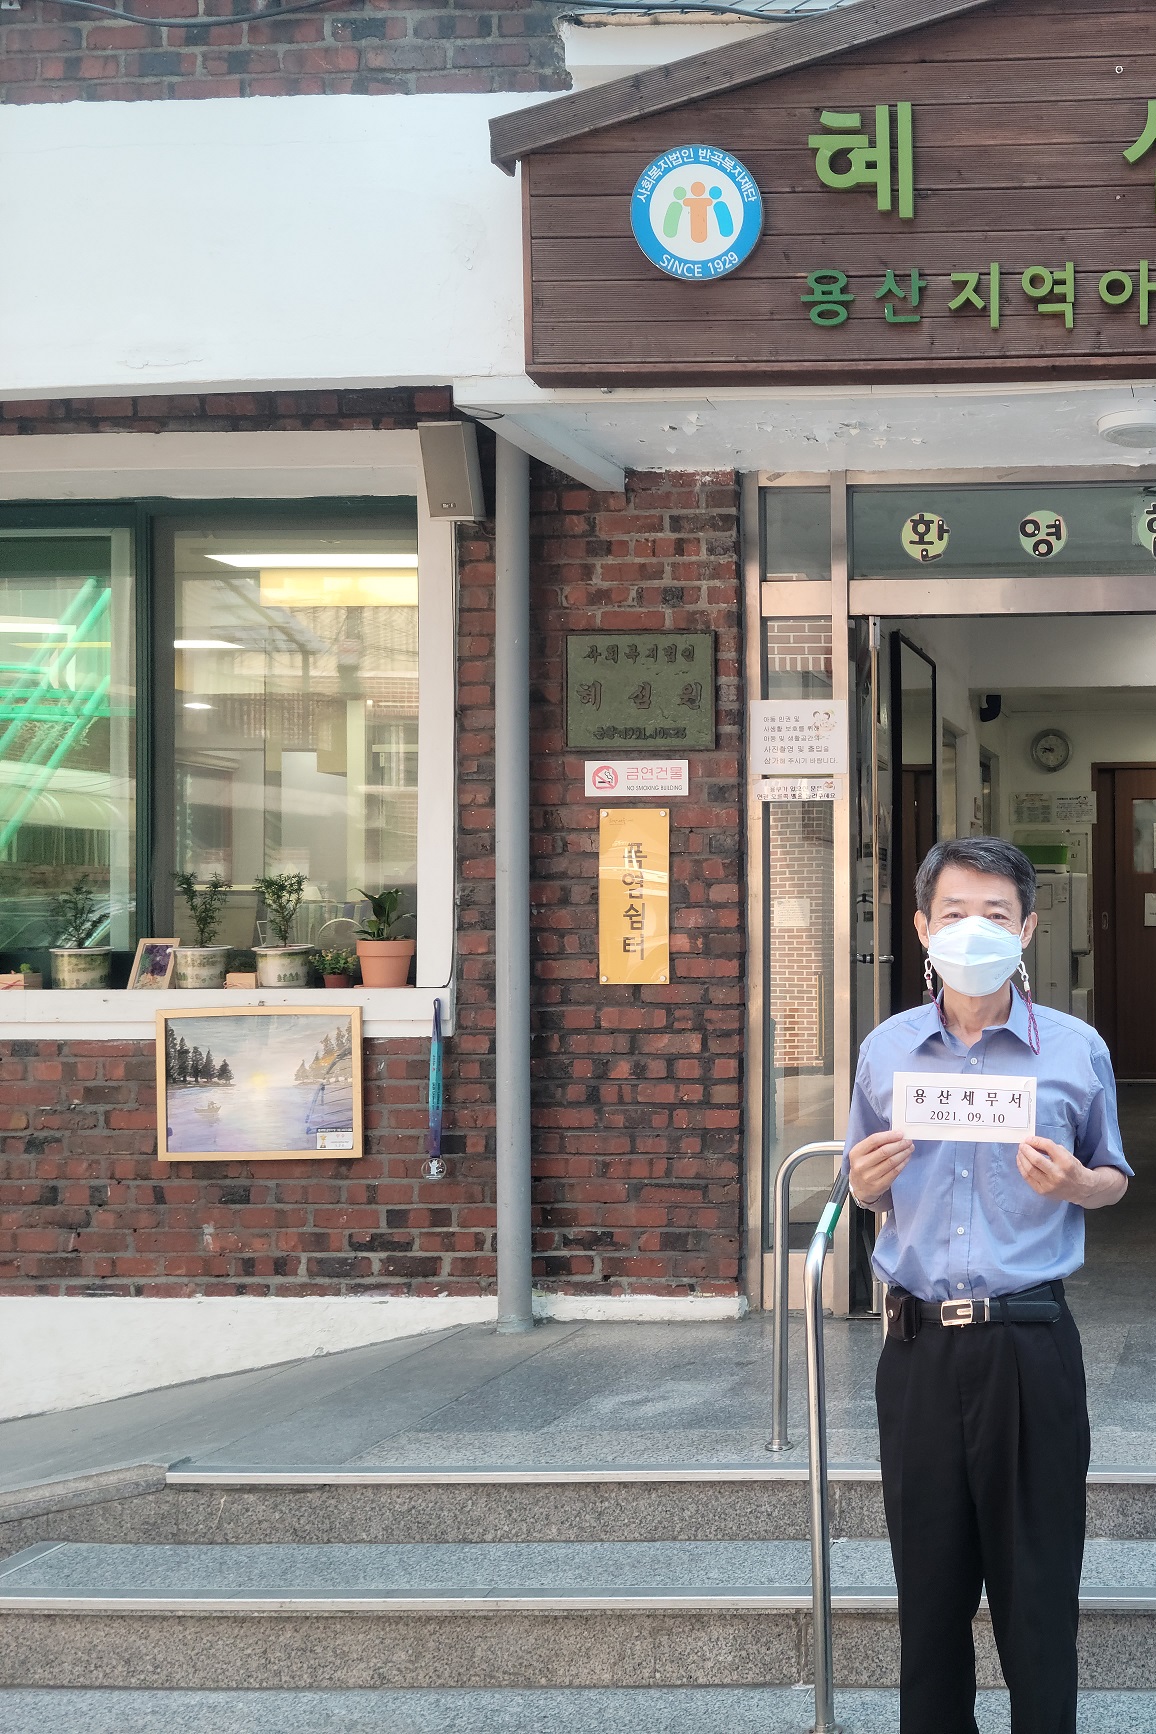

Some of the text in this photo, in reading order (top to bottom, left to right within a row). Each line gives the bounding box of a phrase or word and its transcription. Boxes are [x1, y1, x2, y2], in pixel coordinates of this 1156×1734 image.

[637, 148, 757, 203] 사회복지법인 반곡복지재단
[659, 251, 739, 277] SINCE 1929
[626, 766, 682, 780] 금연건물
[913, 1088, 1023, 1109] 용산세무서
[930, 1110, 1005, 1124] 2021. 09. 10
